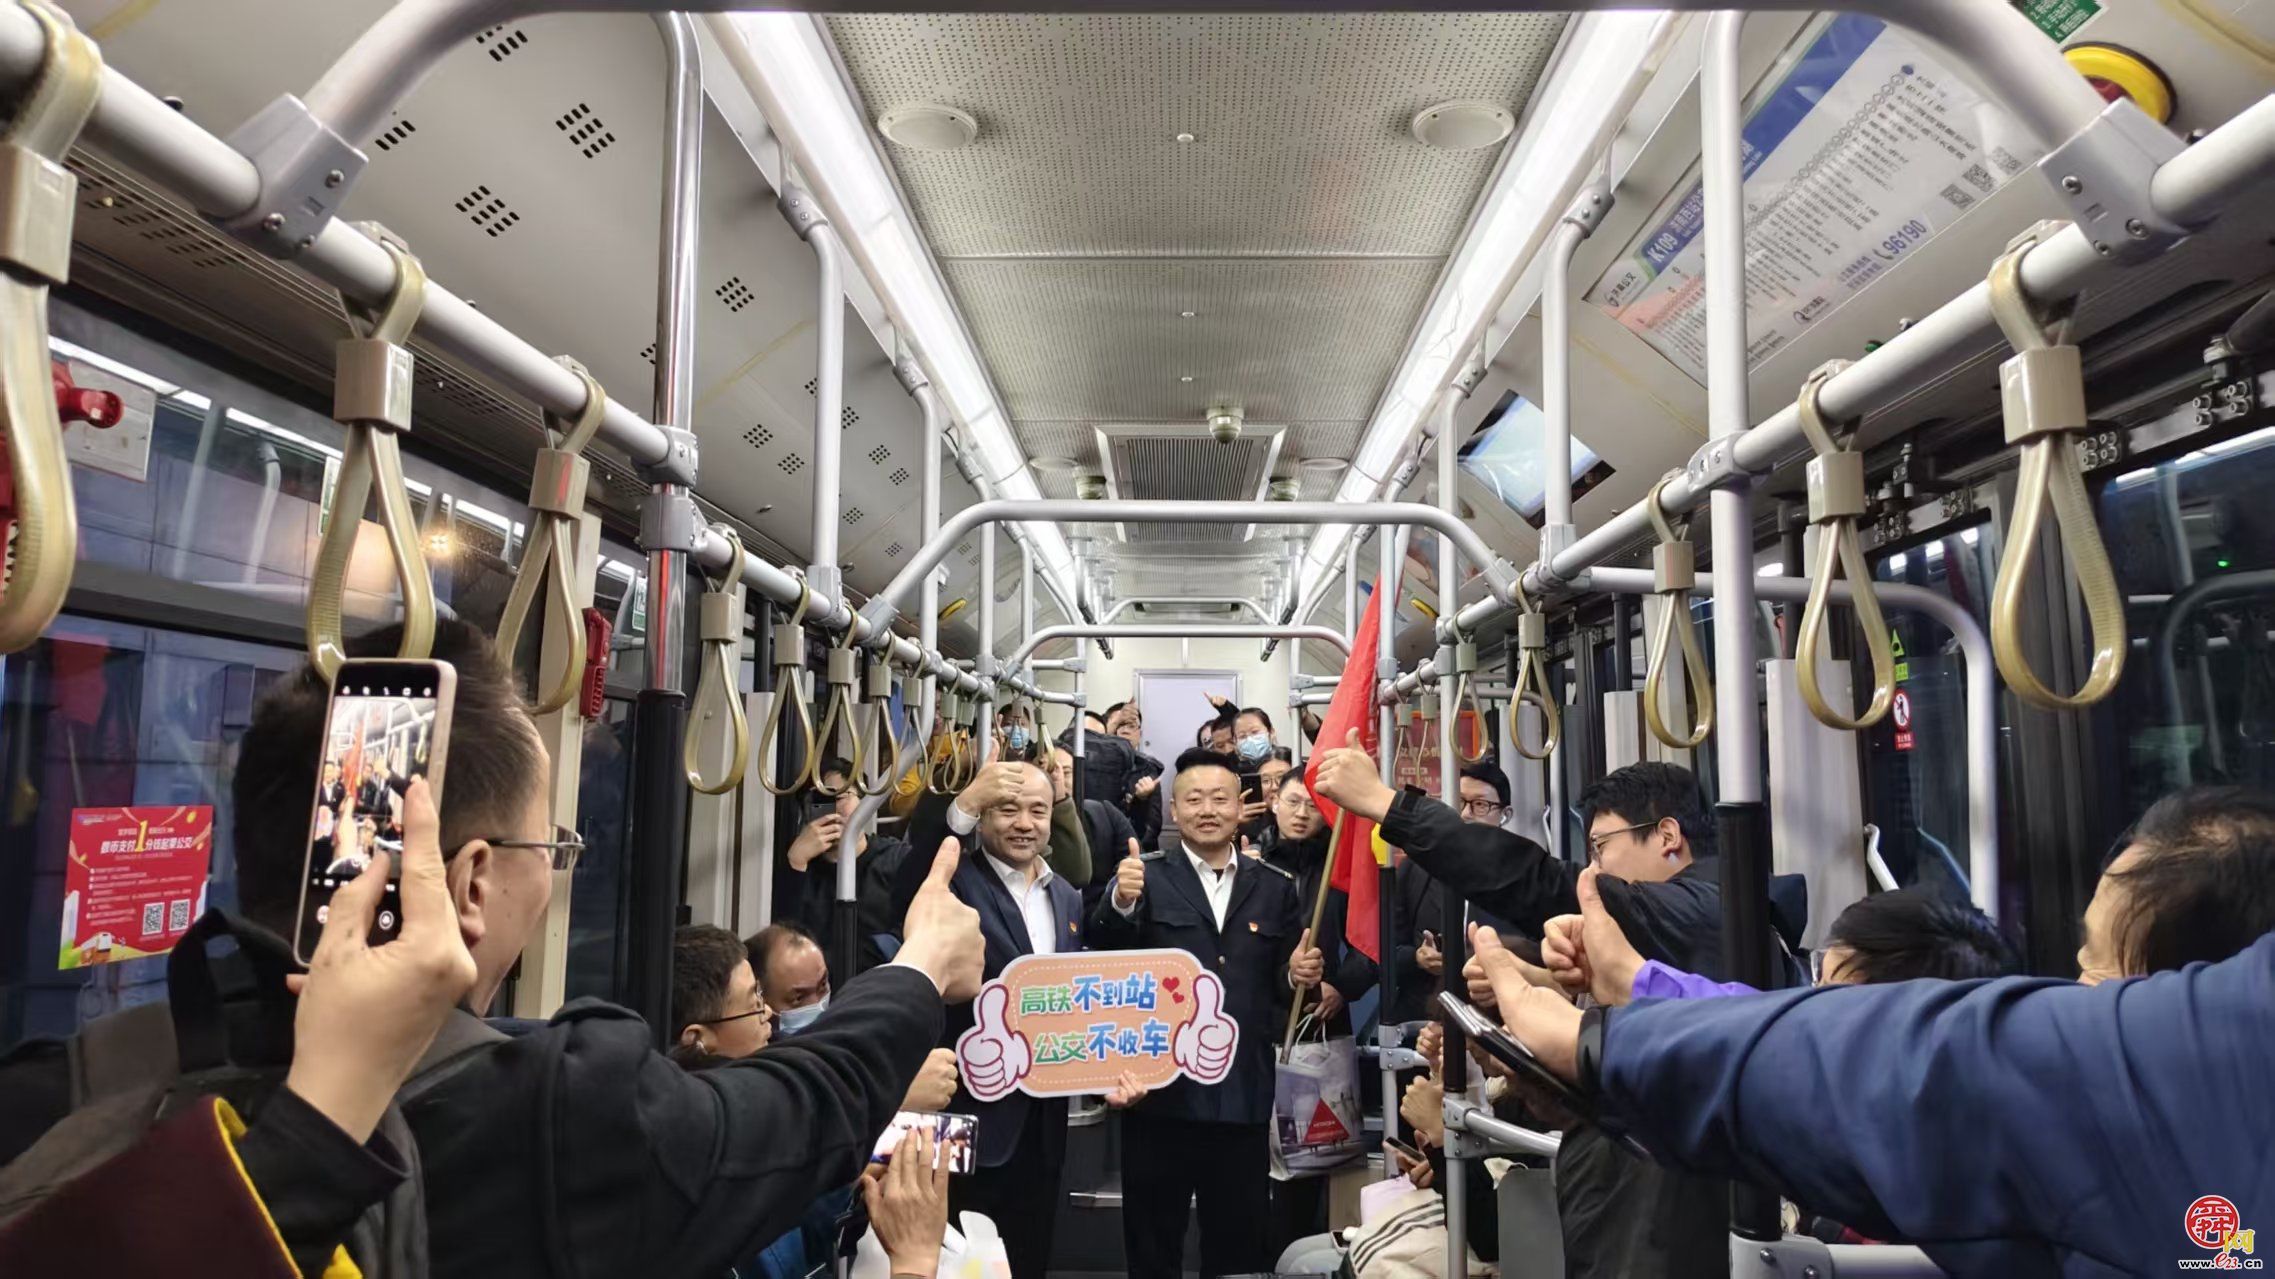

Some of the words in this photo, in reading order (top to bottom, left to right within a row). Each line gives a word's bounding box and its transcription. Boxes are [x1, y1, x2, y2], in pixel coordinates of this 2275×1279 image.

[1647, 231, 1679, 263] K109
[1881, 219, 1927, 255] 96190
[1020, 971, 1157, 1016] 高铁不到站
[1033, 1018, 1170, 1066] 公交不收车
